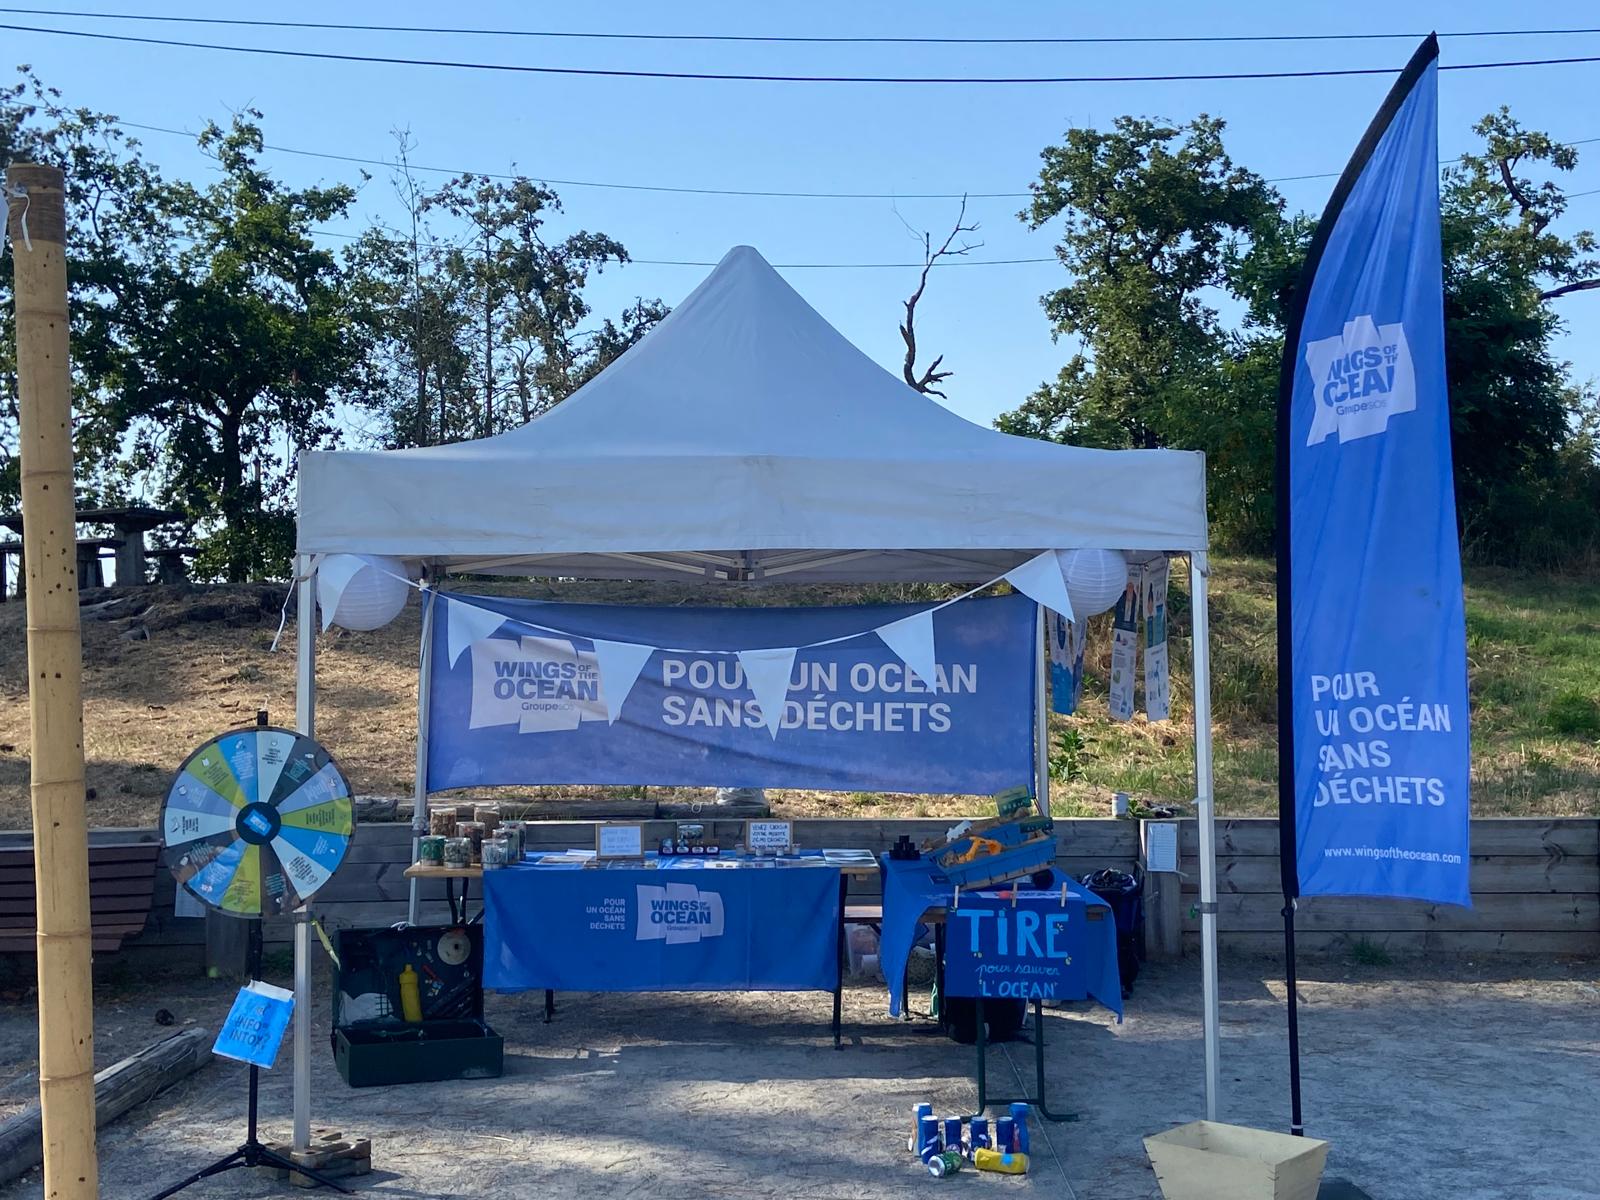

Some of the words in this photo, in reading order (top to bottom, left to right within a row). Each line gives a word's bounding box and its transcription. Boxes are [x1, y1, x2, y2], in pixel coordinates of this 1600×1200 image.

[1384, 353, 1399, 364] TH
[494, 661, 577, 679] WINGS
[578, 664, 592, 672] OF
[578, 672, 599, 680] THE
[662, 659, 753, 690] POU
[493, 678, 599, 701] OCEAN
[662, 695, 767, 728] SANS
[780, 692, 952, 733] DÉCHETS
[1349, 696, 1452, 734] OCÉAN
[1324, 845, 1462, 865] www.wingsoftheocean.com
[603, 897, 626, 906] POUR
[651, 900, 699, 911] WINGS
[585, 905, 598, 914] UN
[598, 905, 626, 914] OCÉAN
[603, 914, 626, 922] SANS
[650, 911, 712, 924] OCEAN
[589, 921, 626, 930] DÉCHETS
